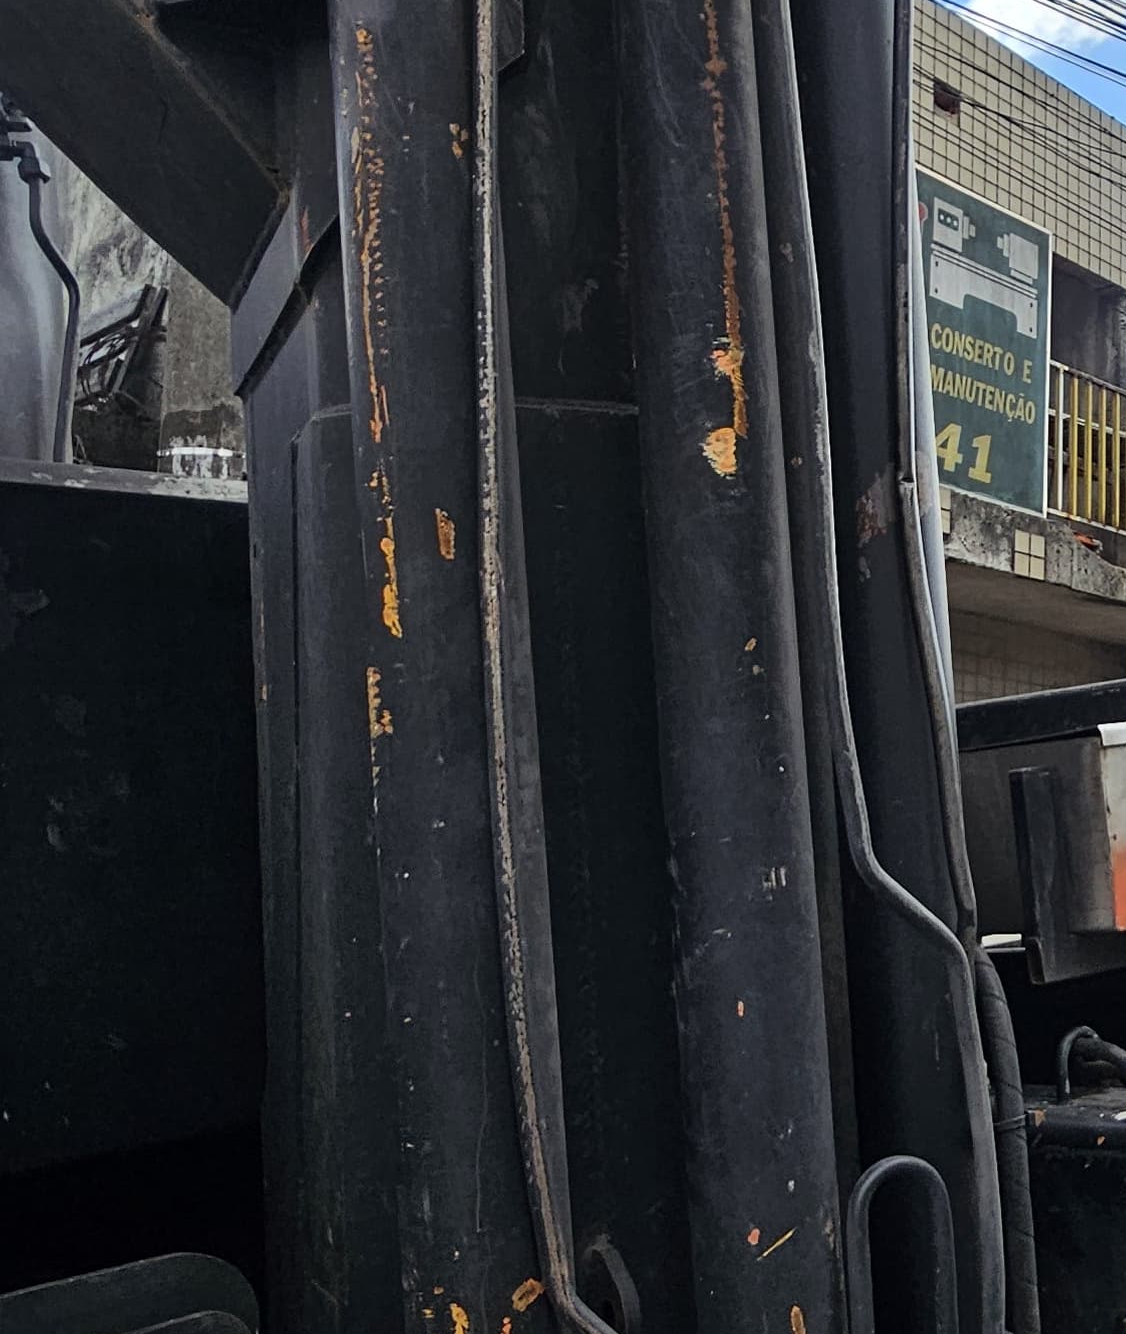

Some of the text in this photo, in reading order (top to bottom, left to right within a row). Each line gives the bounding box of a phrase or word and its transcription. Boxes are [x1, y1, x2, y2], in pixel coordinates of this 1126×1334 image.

[931, 322, 1033, 384] CONSERTO E
[930, 364, 1036, 425] MANUTENÇÃO
[935, 422, 992, 484] 41
